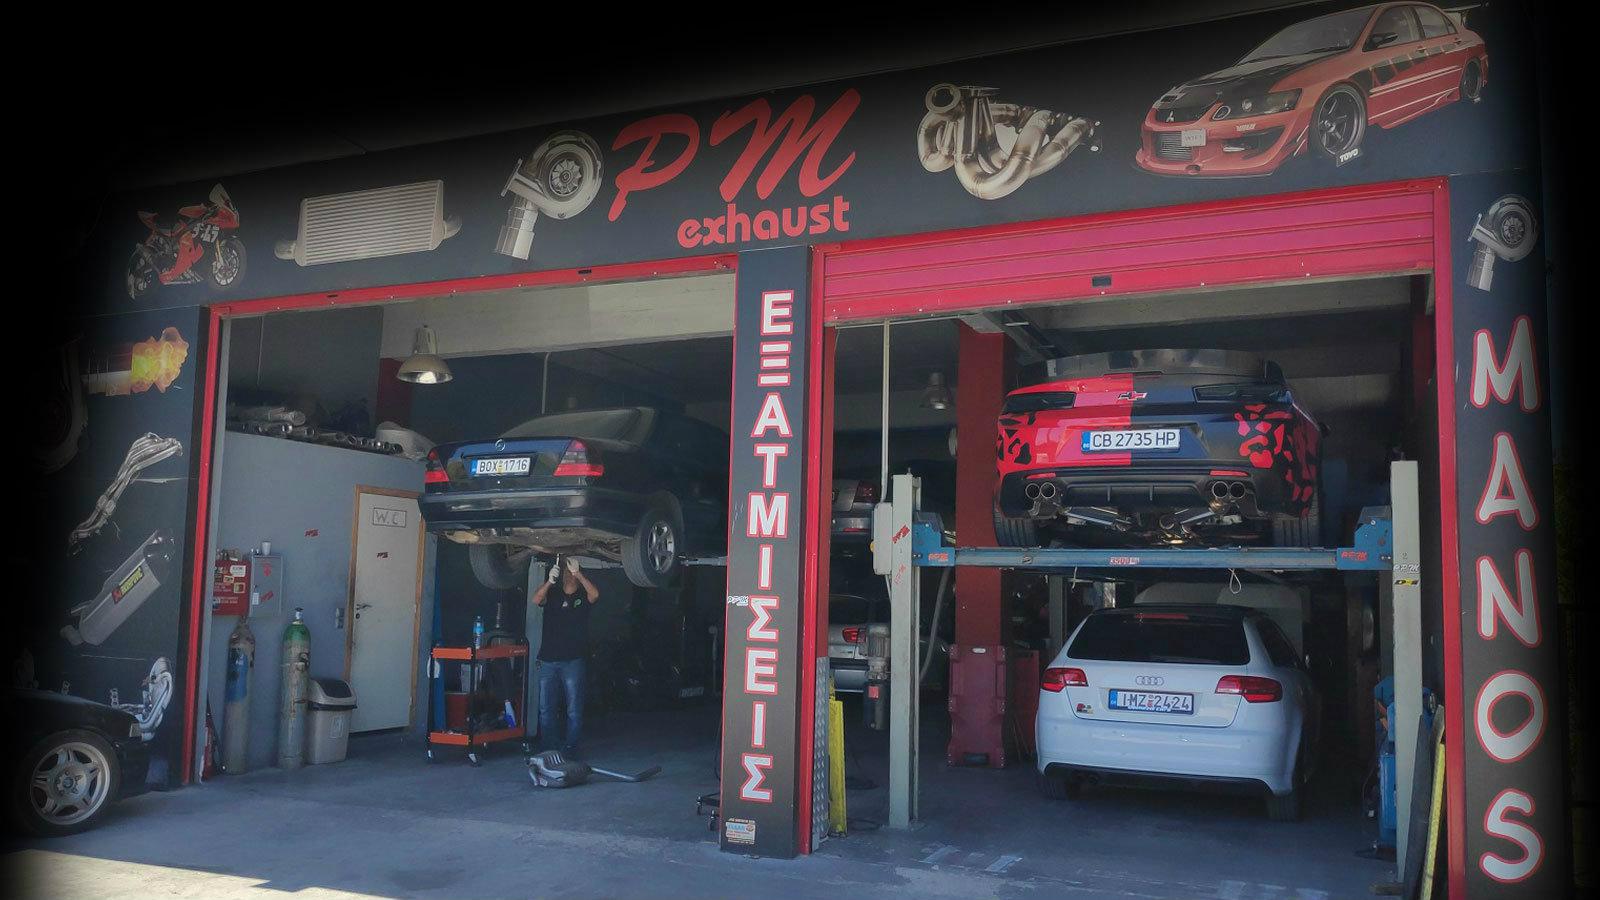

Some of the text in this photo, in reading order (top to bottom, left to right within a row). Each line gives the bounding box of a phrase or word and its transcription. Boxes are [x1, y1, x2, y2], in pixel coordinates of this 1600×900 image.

[608, 88, 861, 222] PM
[677, 195, 851, 249] exhaust
[1092, 431, 1176, 448] CB 2735 HP
[739, 289, 794, 804] ΕΞΑΤΜΙΣΕΙΣ
[1470, 315, 1550, 884] MANOS
[1153, 695, 1191, 710] 2424
